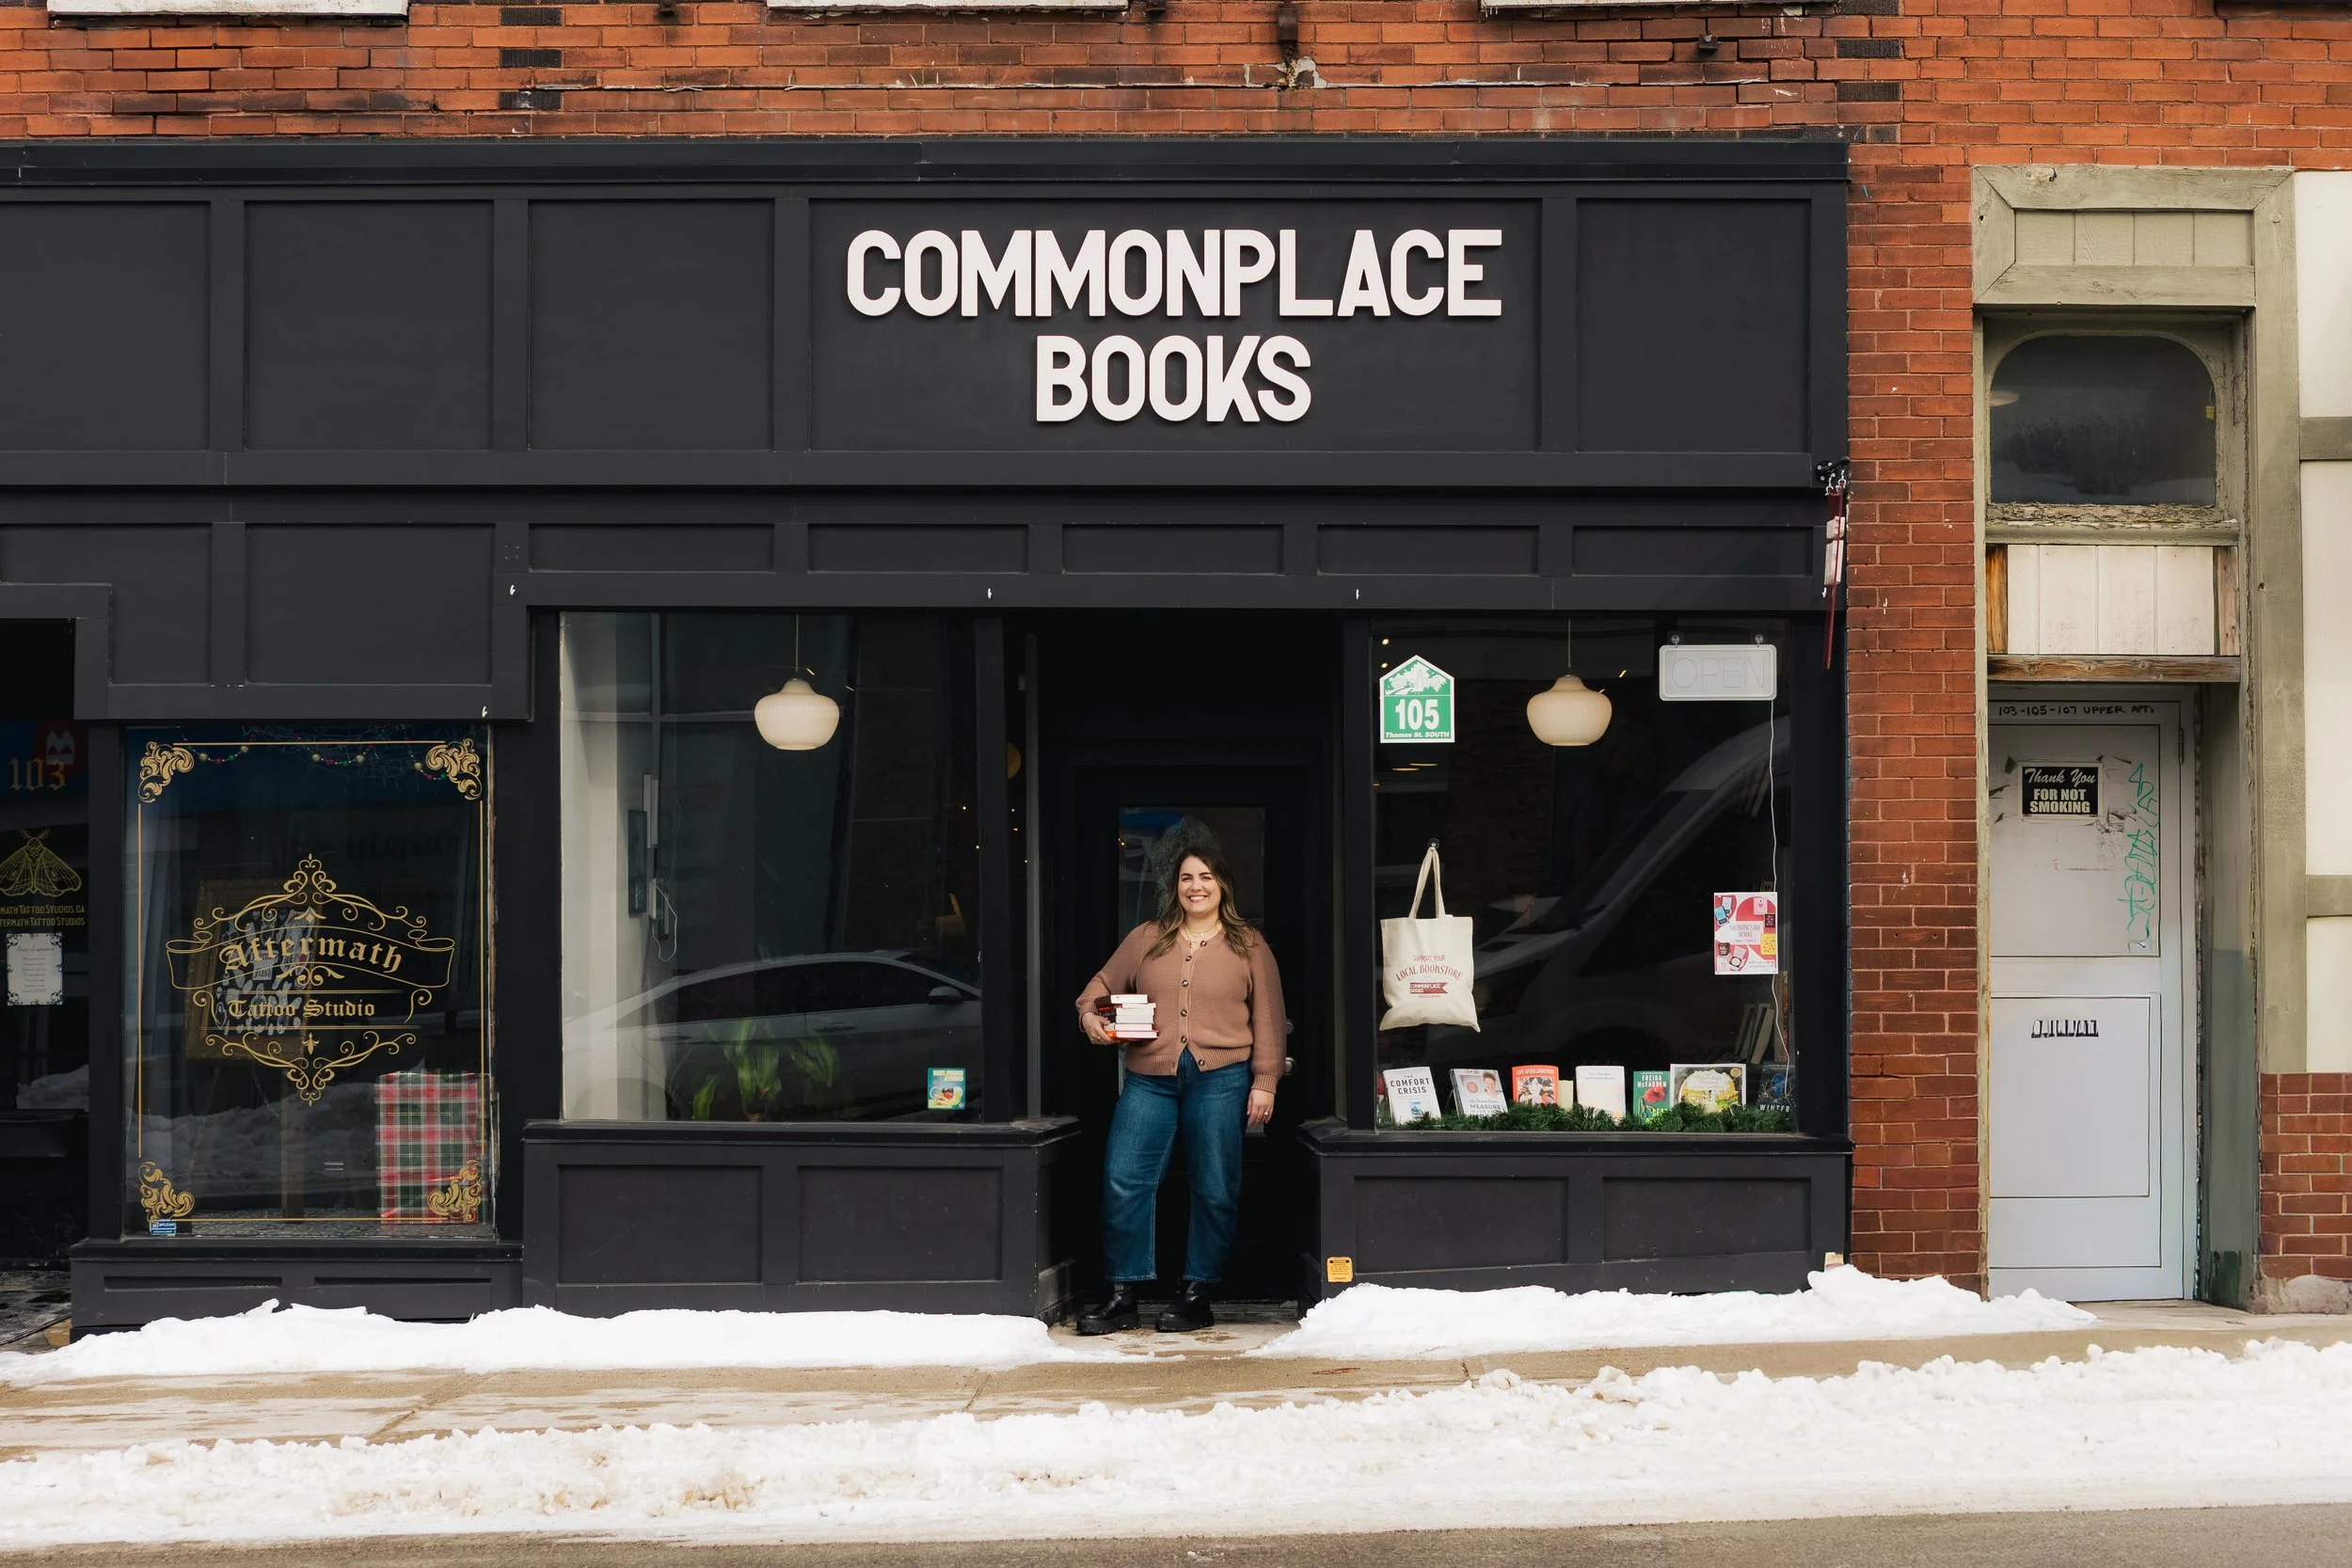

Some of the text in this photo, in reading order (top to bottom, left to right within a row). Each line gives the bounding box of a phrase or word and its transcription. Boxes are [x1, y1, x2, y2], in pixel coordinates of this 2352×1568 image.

[847, 229, 1503, 317] COMMONPLACE
[1036, 335, 1311, 423] BOOKS
[1672, 657, 1765, 691] OPEN
[1395, 699, 1439, 730] 105
[2083, 705, 2126, 715] UPPER
[8, 757, 68, 791] 103
[2024, 768, 2096, 787] Thank You
[2033, 788, 2087, 800] FOR NOT
[2029, 800, 2090, 813] SMOKING
[218, 937, 403, 974] Aftermath
[1395, 965, 1464, 981] LOCAL BOOKSTORE
[228, 998, 375, 1018] Tattoo Studio
[1390, 1077, 1430, 1087] COMFORT
[1397, 1086, 1427, 1095] CRISIS
